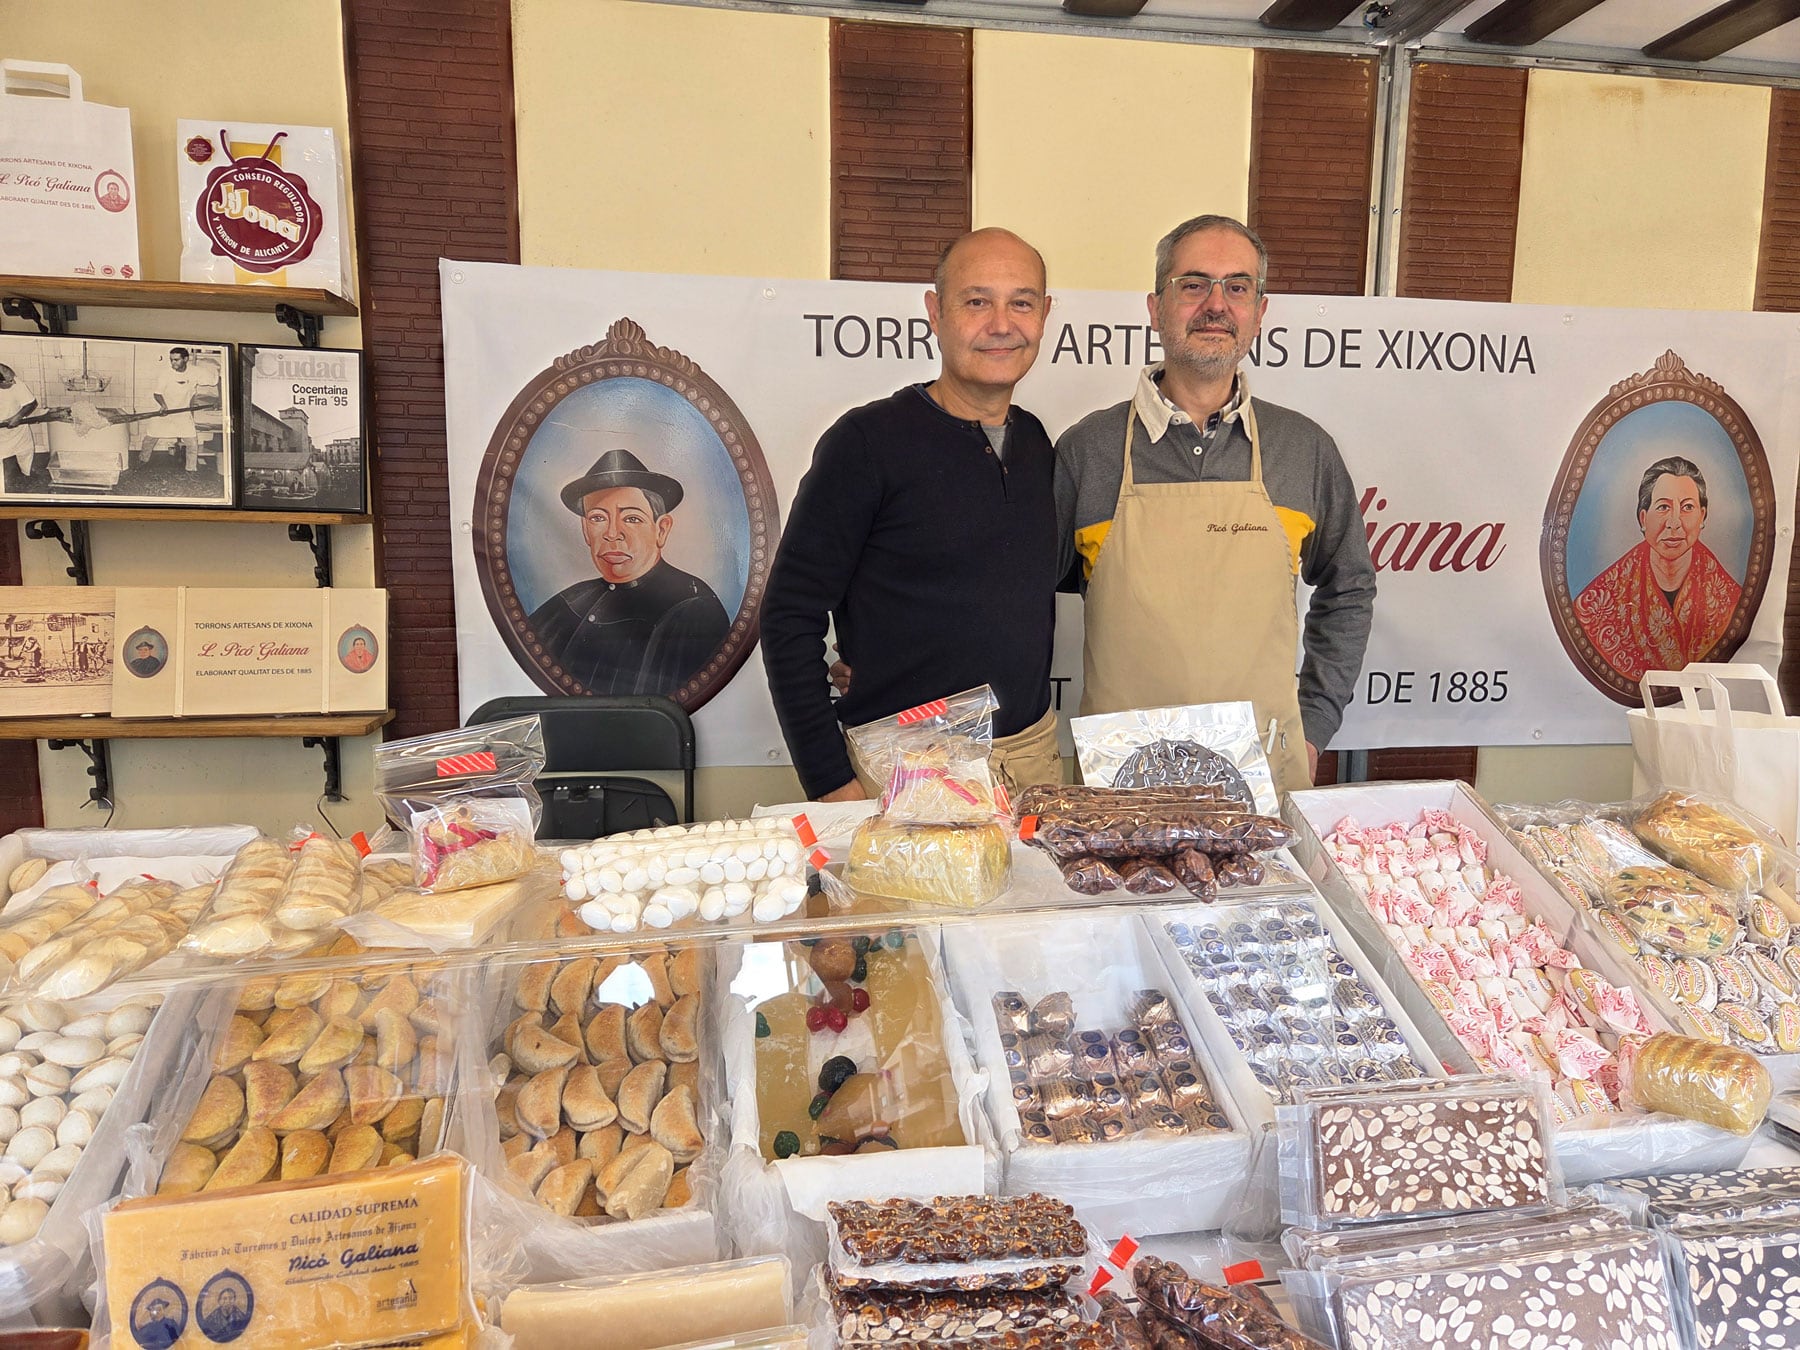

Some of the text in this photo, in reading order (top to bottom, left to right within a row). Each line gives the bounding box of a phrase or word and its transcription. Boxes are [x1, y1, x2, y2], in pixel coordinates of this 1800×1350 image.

[23, 158, 57, 167] ARTESANS
[14, 174, 41, 187] Picó
[44, 176, 92, 193] Galiana
[31, 198, 59, 206] QUALITAT
[233, 173, 304, 224] CONSEJO REGULADOR
[212, 215, 290, 257] Y TURRON DE ALICANTE
[804, 314, 934, 360] TORR
[1304, 328, 1362, 368] DE
[1375, 329, 1536, 374] XIXONA
[255, 352, 346, 379] Ciudad
[292, 384, 348, 396] Cocentaina
[293, 395, 305, 405] La
[308, 395, 327, 406] Fira
[1231, 522, 1269, 536] Galiana
[194, 622, 231, 630] TORRONS
[285, 621, 313, 629] XIXONA
[220, 642, 255, 657] Picó
[256, 641, 310, 660] Galiana
[1367, 670, 1508, 705] DE 1885
[289, 1198, 419, 1224] CALIDAD SUPREMA
[221, 1247, 230, 1256] de
[234, 1242, 278, 1254] Turrones
[290, 1235, 321, 1246] Dulces
[326, 1228, 373, 1242] Artesanos
[375, 1225, 385, 1234] de
[340, 1244, 419, 1269] Galiana
